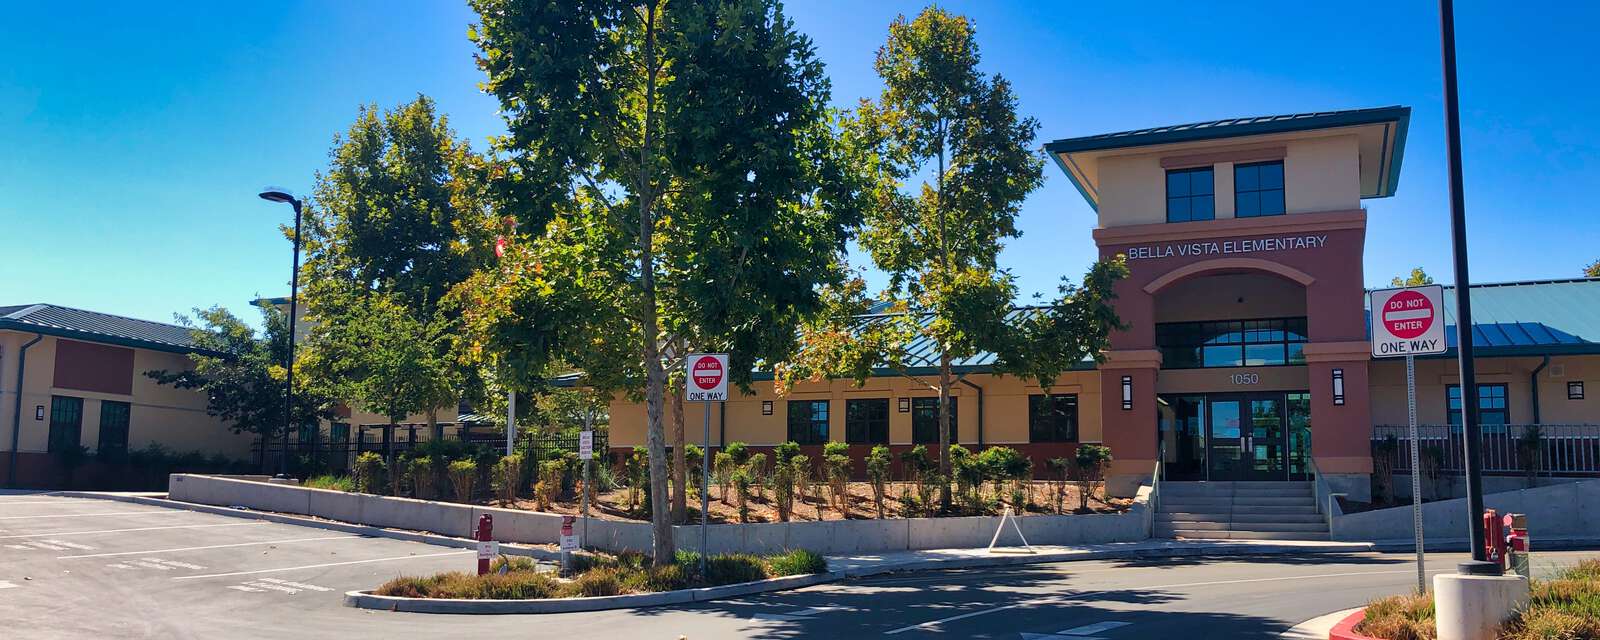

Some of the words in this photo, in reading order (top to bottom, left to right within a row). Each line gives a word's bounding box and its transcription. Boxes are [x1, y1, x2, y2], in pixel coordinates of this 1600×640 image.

[1129, 246, 1175, 260] BELLA
[1177, 242, 1220, 257] VISTA
[1223, 235, 1327, 254] ELEMENTARY
[1390, 300, 1403, 309] DO
[1406, 298, 1424, 308] NOT
[1394, 320, 1423, 331] ENTER
[1380, 341, 1406, 354] ONE
[1410, 339, 1438, 351] WAY
[1230, 373, 1259, 385] 1050
[690, 392, 705, 400] ONE
[707, 392, 723, 400] WAY
